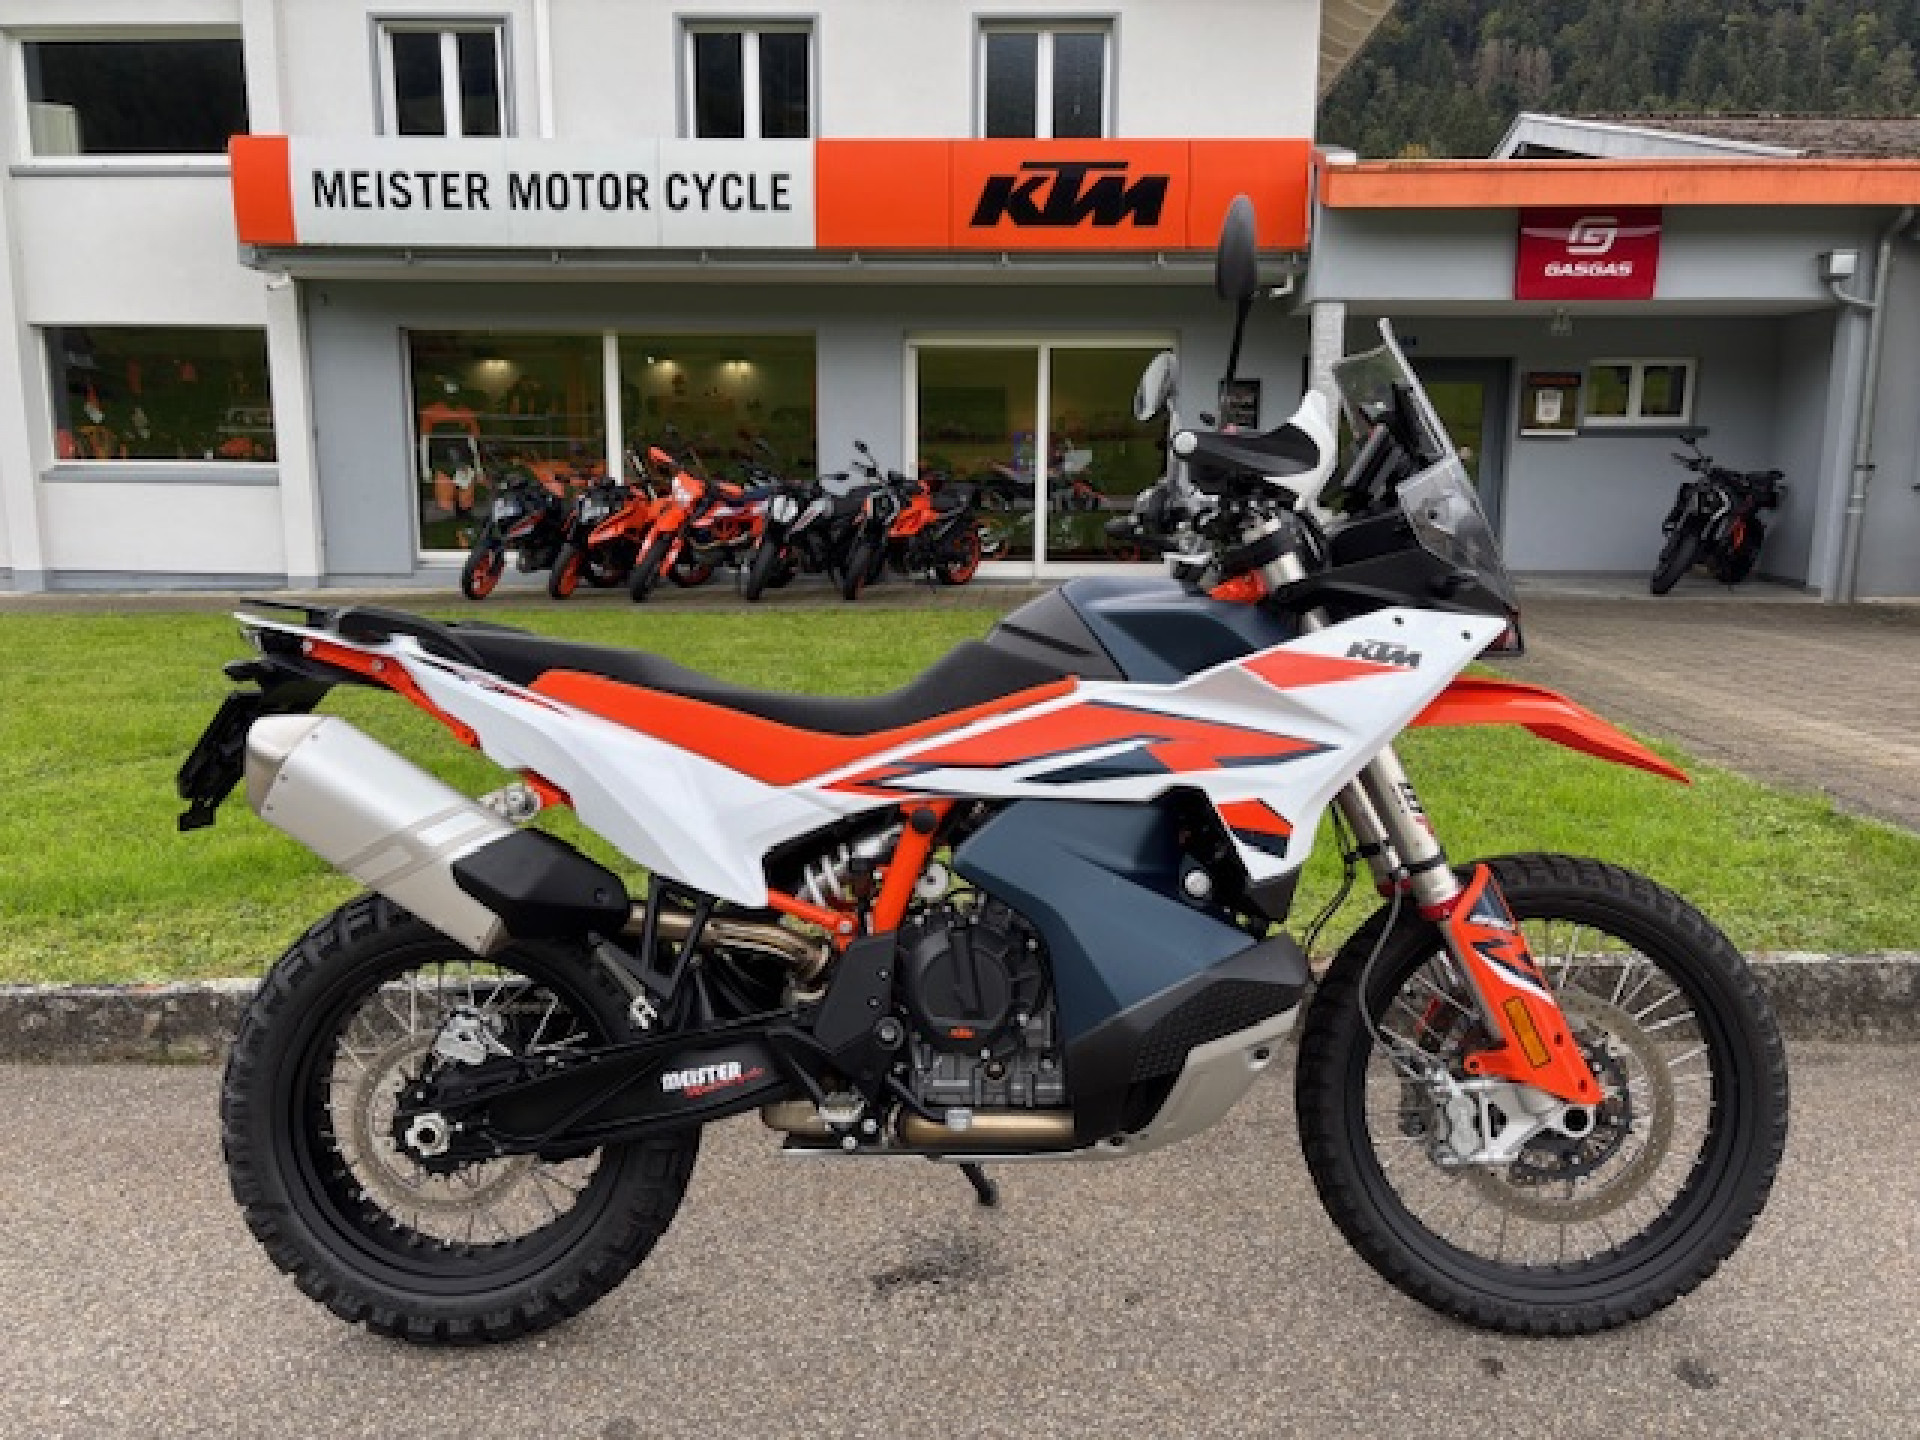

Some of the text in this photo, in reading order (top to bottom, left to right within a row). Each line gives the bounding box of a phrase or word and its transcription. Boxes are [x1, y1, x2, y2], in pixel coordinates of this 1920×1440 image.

[312, 169, 792, 211] MEISTER MOTOR CYCLE
[969, 161, 1170, 228] KTM
[1544, 260, 1633, 277] GASGAS
[1345, 639, 1422, 669] KTM
